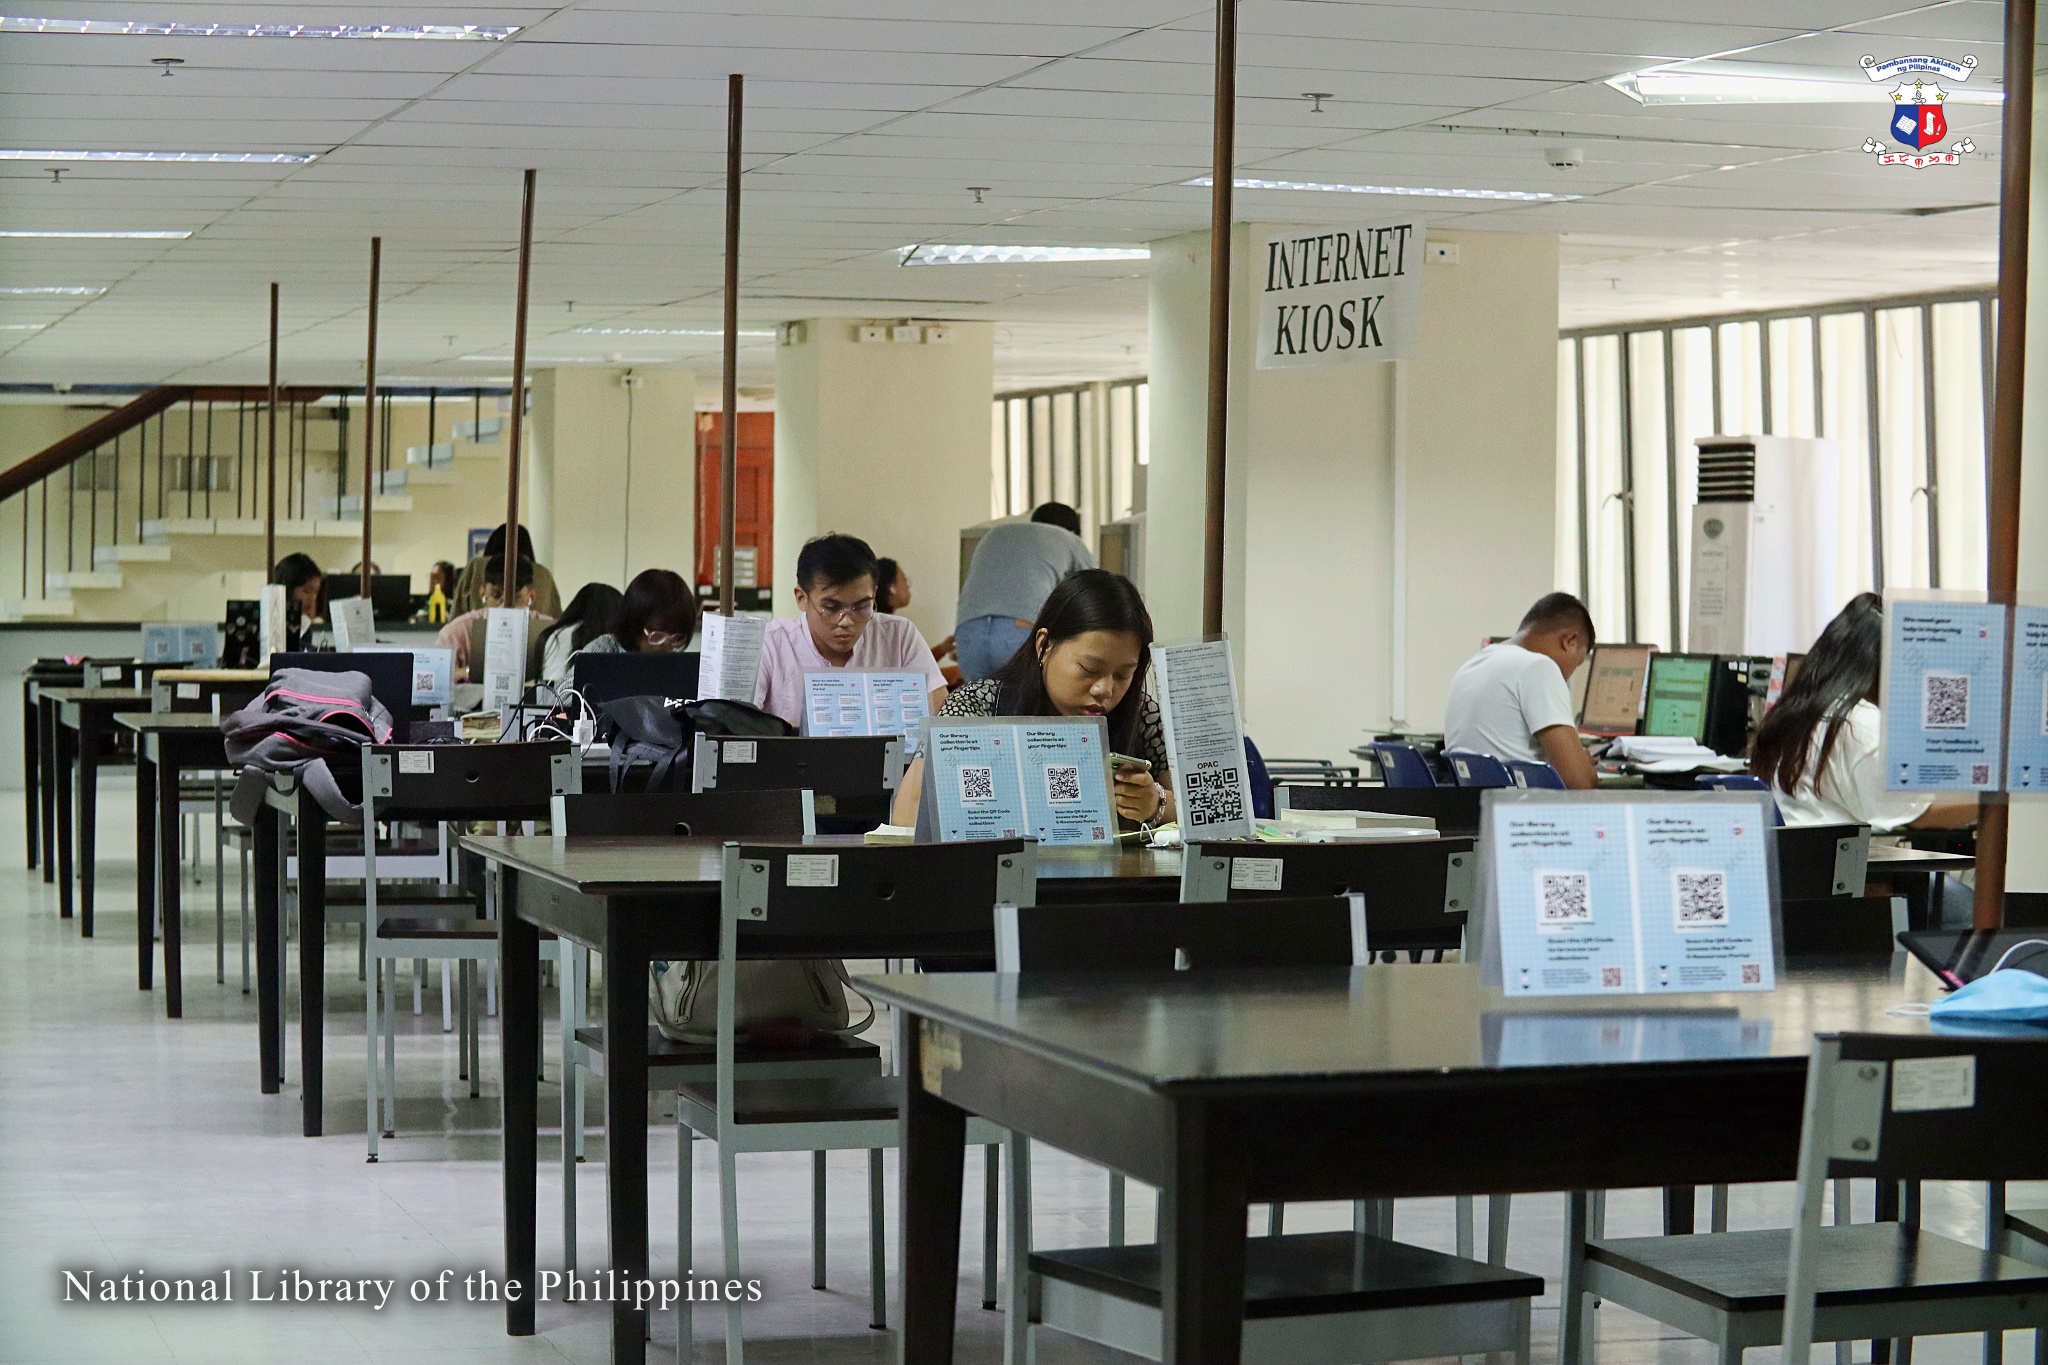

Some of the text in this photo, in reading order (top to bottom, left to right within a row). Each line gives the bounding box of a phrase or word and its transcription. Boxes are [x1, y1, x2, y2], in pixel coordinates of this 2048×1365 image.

[1265, 224, 1412, 292] INTERNET
[1274, 295, 1385, 355] KIOSK
[1197, 761, 1219, 769] OPAC
